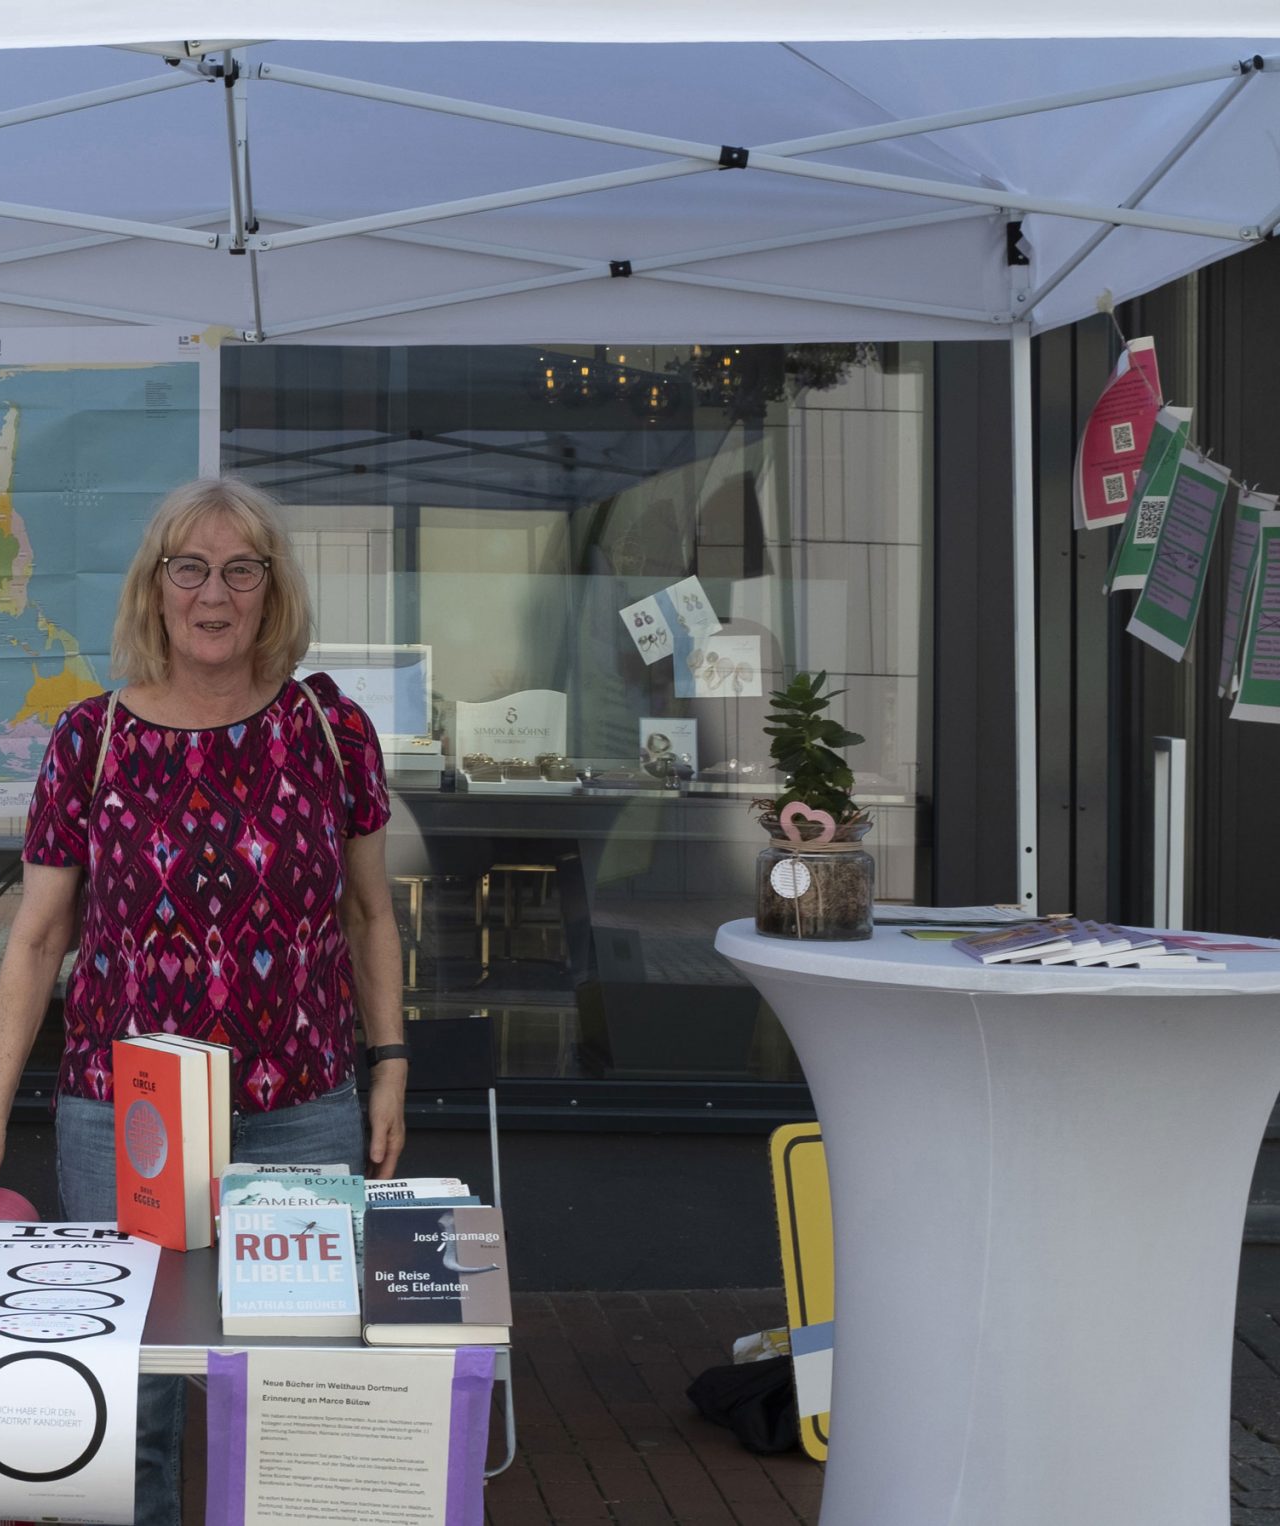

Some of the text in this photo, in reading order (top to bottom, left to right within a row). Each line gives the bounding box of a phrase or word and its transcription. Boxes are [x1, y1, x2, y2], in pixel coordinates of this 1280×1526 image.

[132, 1078, 157, 1092] CIRCLE
[257, 1166, 322, 1174] Jules Verne
[304, 1177, 359, 1186] BOYLE
[133, 1193, 160, 1209] EGGERS
[367, 1190, 415, 1201] FISCHER
[234, 1213, 277, 1231] DIE
[11, 1226, 132, 1241] ICH
[413, 1231, 500, 1243] José Saramago
[235, 1233, 342, 1261] ROTE
[236, 1264, 345, 1283] LIBELLE
[375, 1270, 430, 1281] Die Reise
[387, 1282, 469, 1292] des Elefanten
[262, 1379, 408, 1393] Neue Bücher im Welthaus Dortmund
[262, 1394, 306, 1405] Erinnerung
[319, 1396, 344, 1405] Marco
[345, 1397, 371, 1407] Bülow
[0, 1406, 76, 1417] ICH HABE FÜR DEN
[33, 1417, 83, 1428] KANDIDIERT
